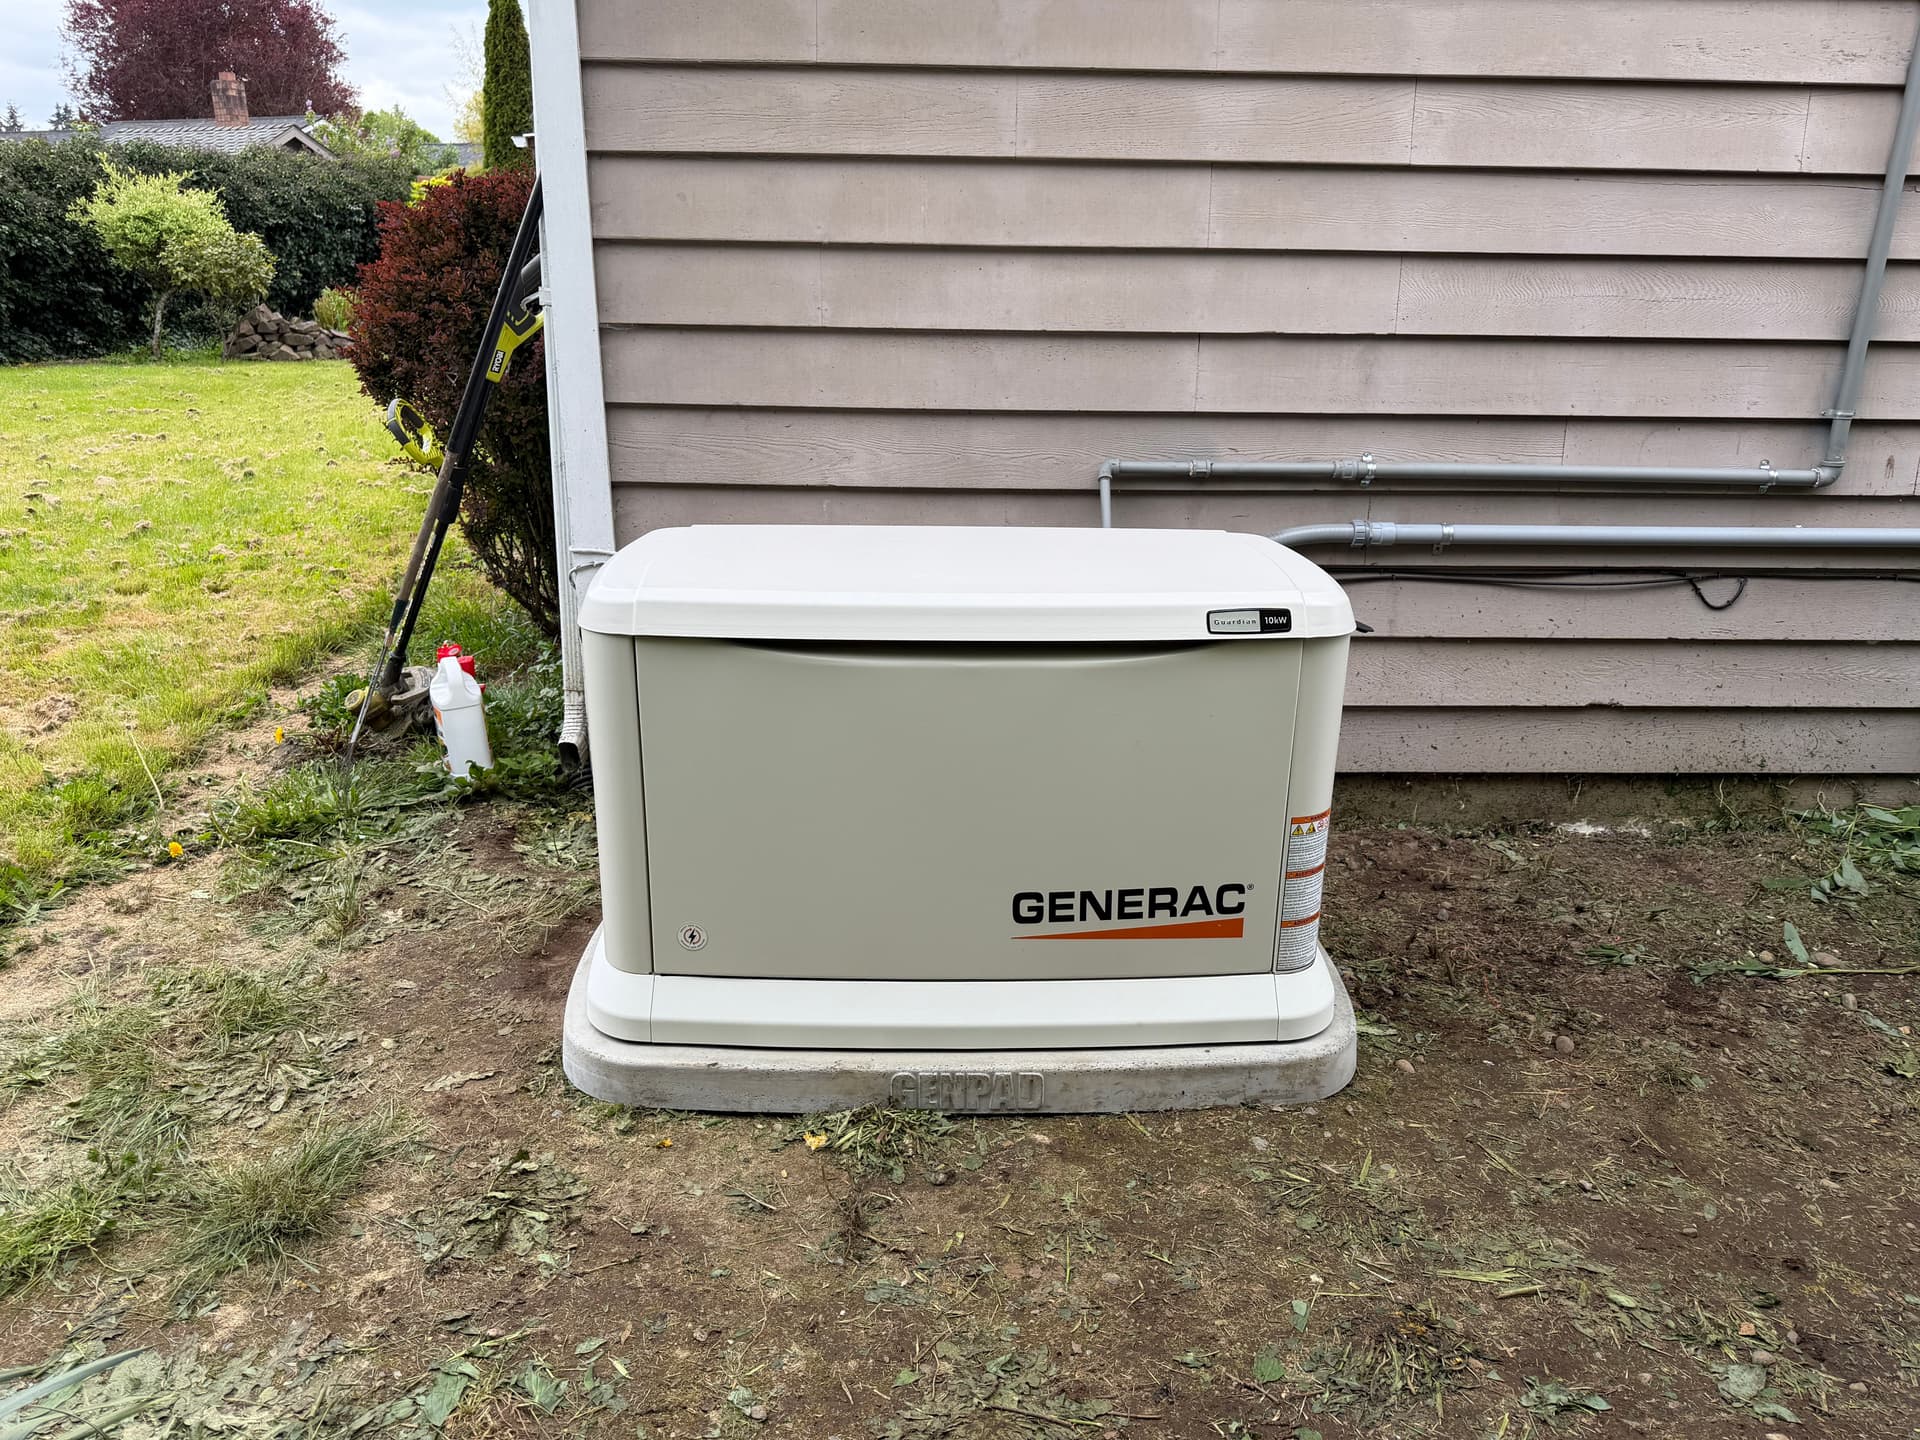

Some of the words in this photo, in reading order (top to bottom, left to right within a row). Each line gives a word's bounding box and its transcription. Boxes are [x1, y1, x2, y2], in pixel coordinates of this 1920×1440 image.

[492, 351, 505, 372] RYOBI
[1214, 617, 1257, 625] Guardian
[1264, 616, 1288, 625] 10kW
[1012, 883, 1246, 925] GENERAC
[890, 1072, 1045, 1111] GENPAD
